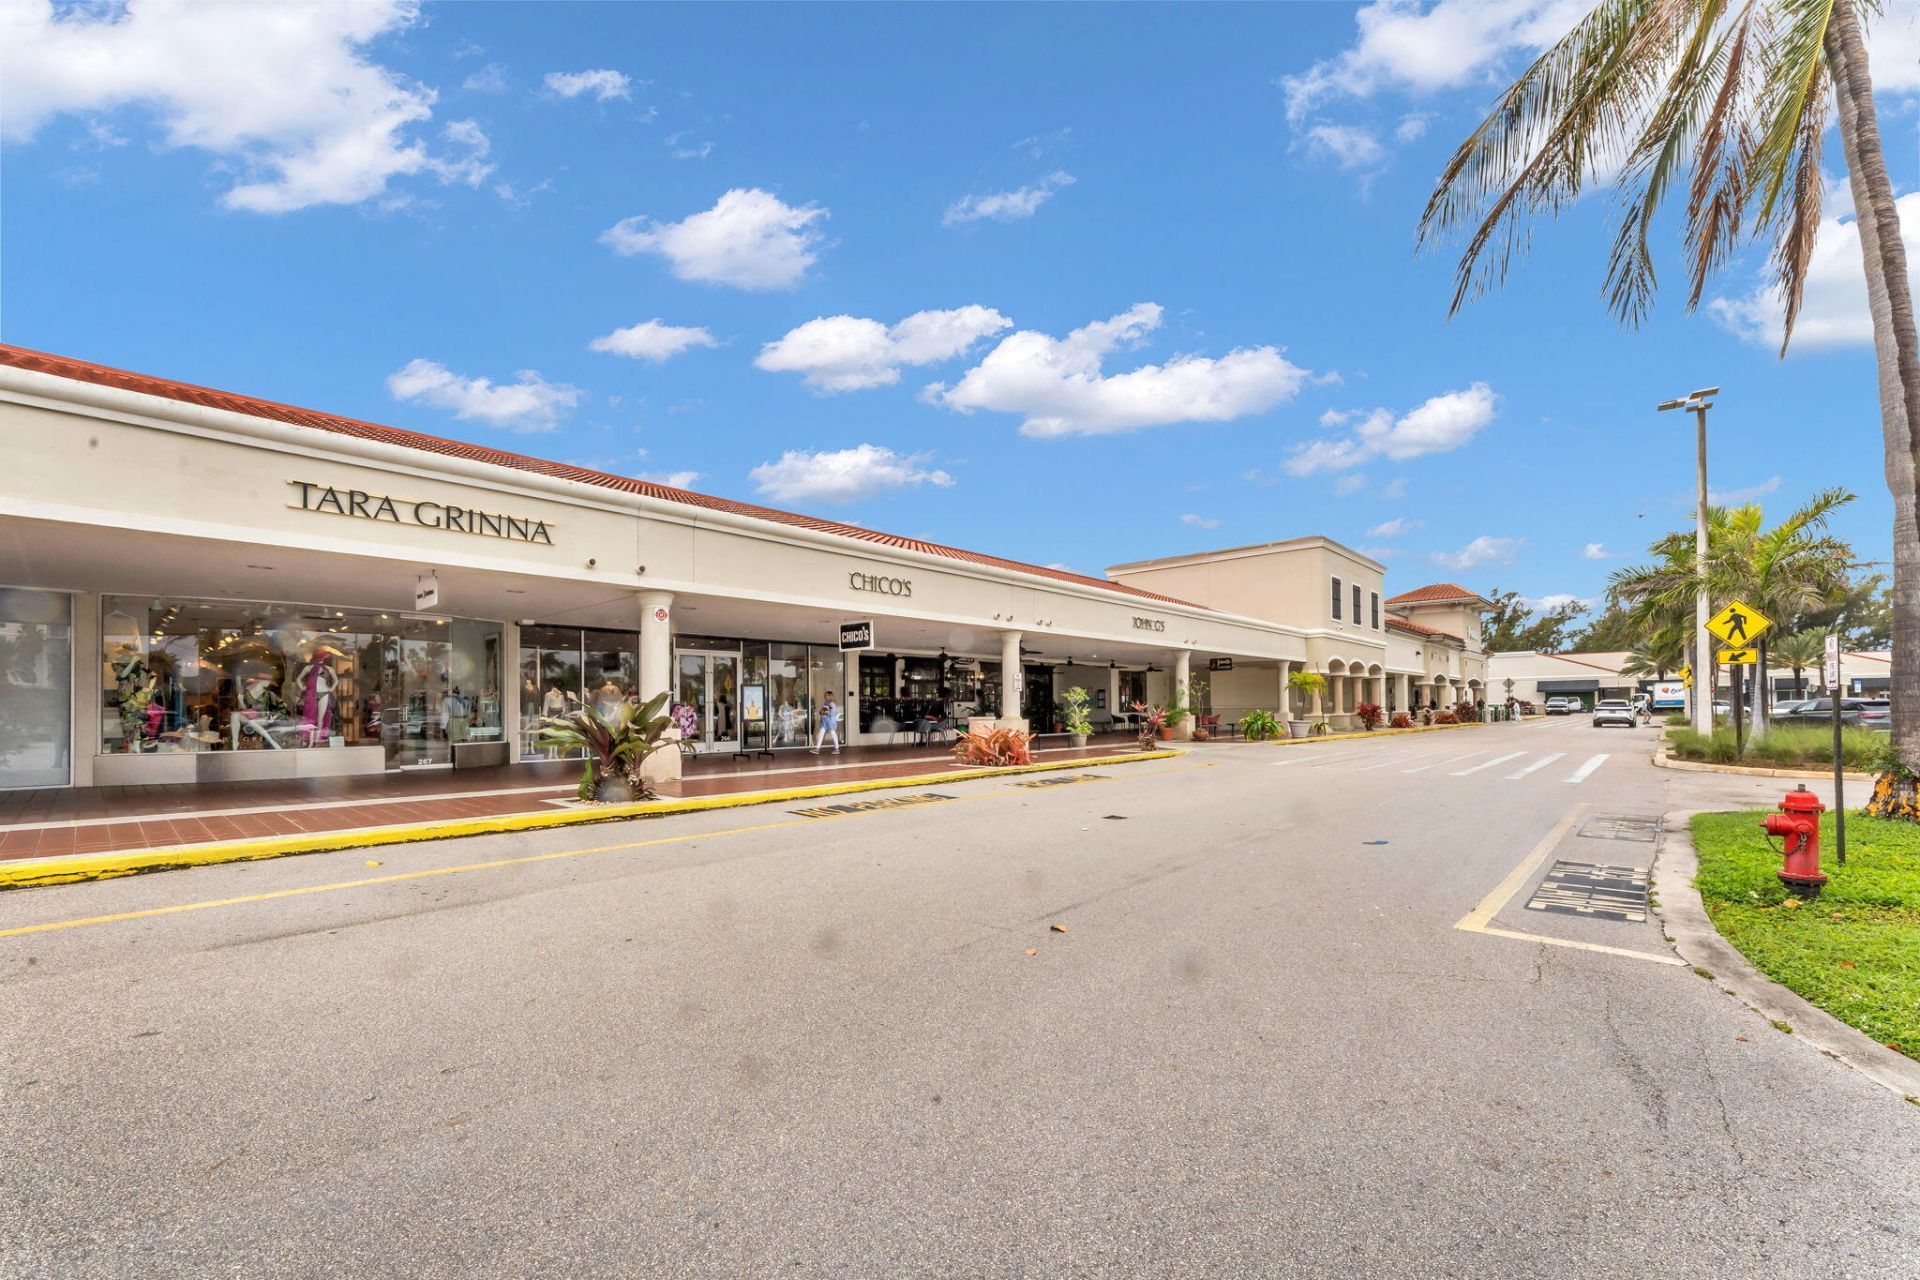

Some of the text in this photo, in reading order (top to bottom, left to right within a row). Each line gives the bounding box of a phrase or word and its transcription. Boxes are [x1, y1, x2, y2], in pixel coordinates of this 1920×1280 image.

[292, 480, 552, 544] TARA GRINNA
[849, 572, 912, 597] CHICO'S
[1132, 616, 1153, 631] JOHN
[841, 626, 869, 643] CHICO'S
